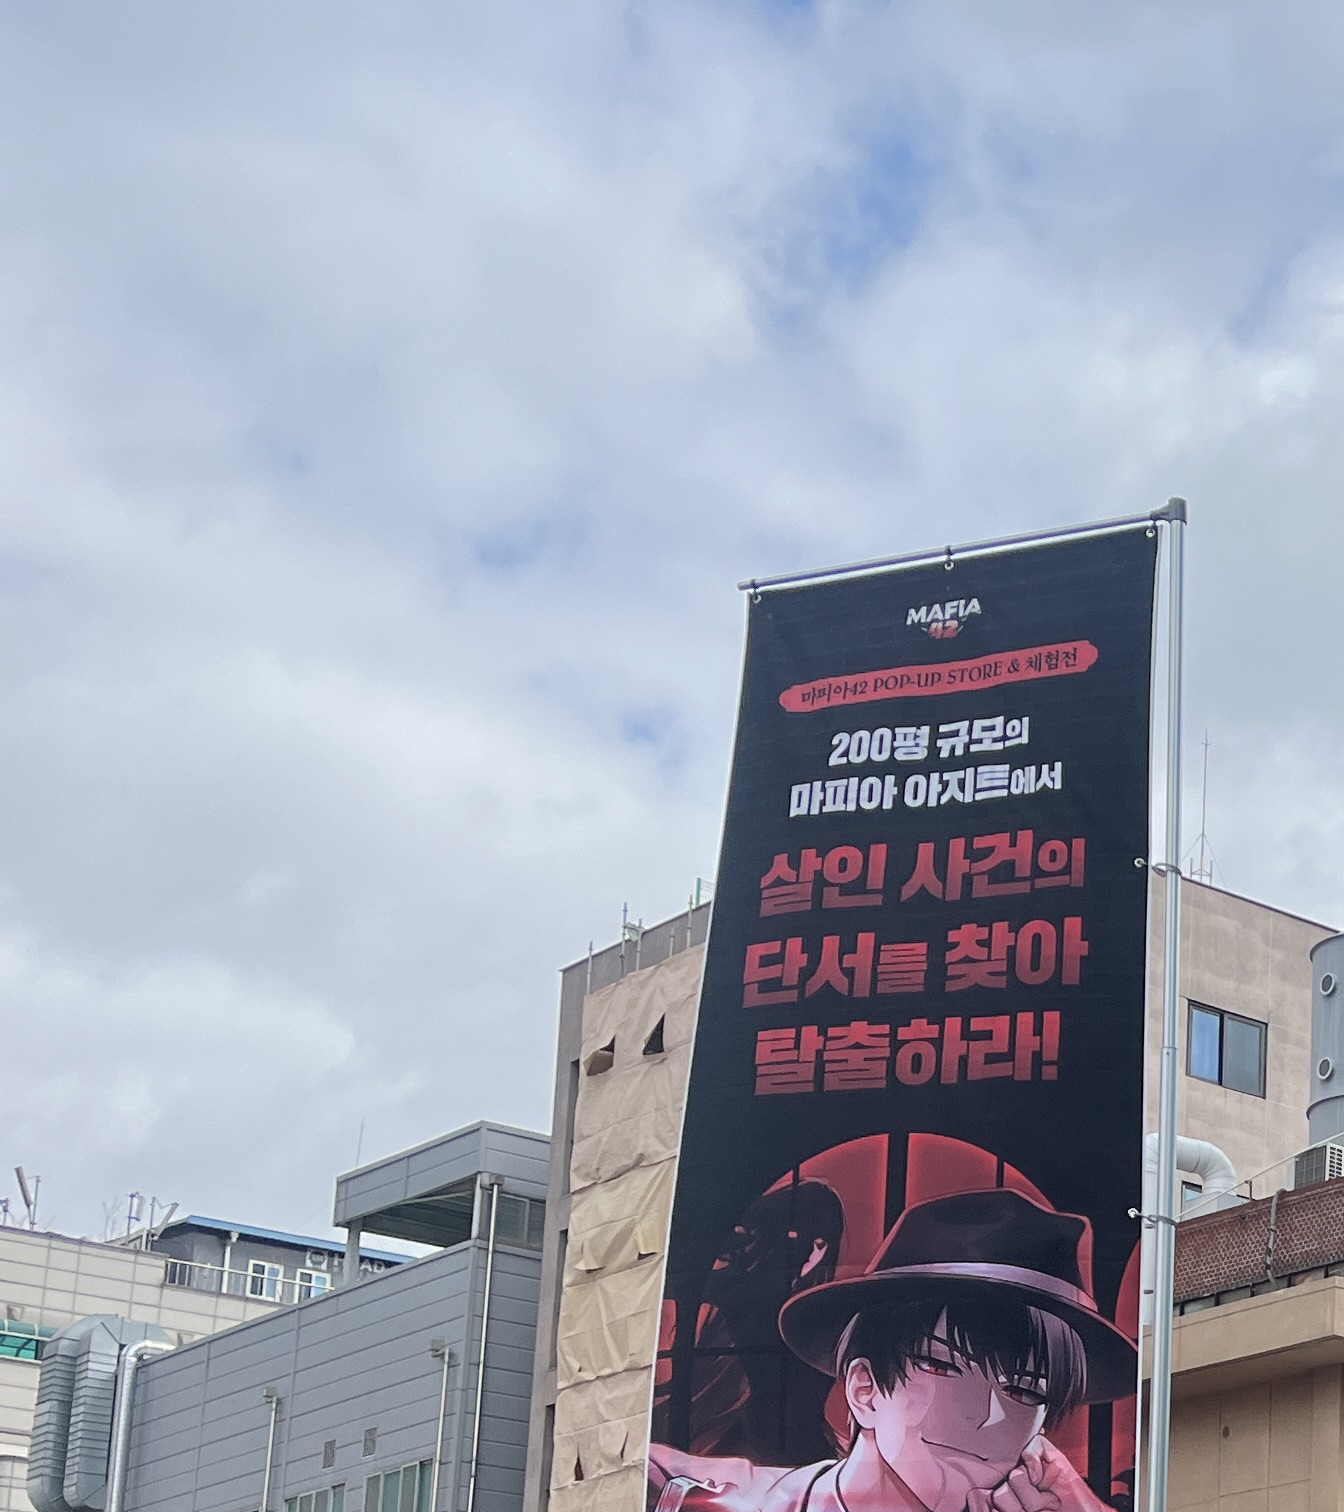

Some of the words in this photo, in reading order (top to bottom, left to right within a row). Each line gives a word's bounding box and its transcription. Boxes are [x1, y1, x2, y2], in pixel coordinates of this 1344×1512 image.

[907, 598, 981, 626] MAFIA
[801, 678, 868, 706] 마피아42
[873, 670, 942, 693] POP-UP
[947, 661, 1003, 686] STORE
[1007, 657, 1021, 675] &
[1025, 646, 1079, 675] 체험전
[828, 725, 930, 767] 200평
[936, 716, 1031, 758] 규모의
[789, 776, 898, 818] 마피아
[904, 762, 1063, 808] 아지트에서
[759, 843, 888, 918] 살인
[901, 829, 1087, 902] 사건의
[742, 932, 929, 1008] 단서를
[945, 916, 1090, 993] 찾아
[753, 1011, 1063, 1097] 탈출하라!
